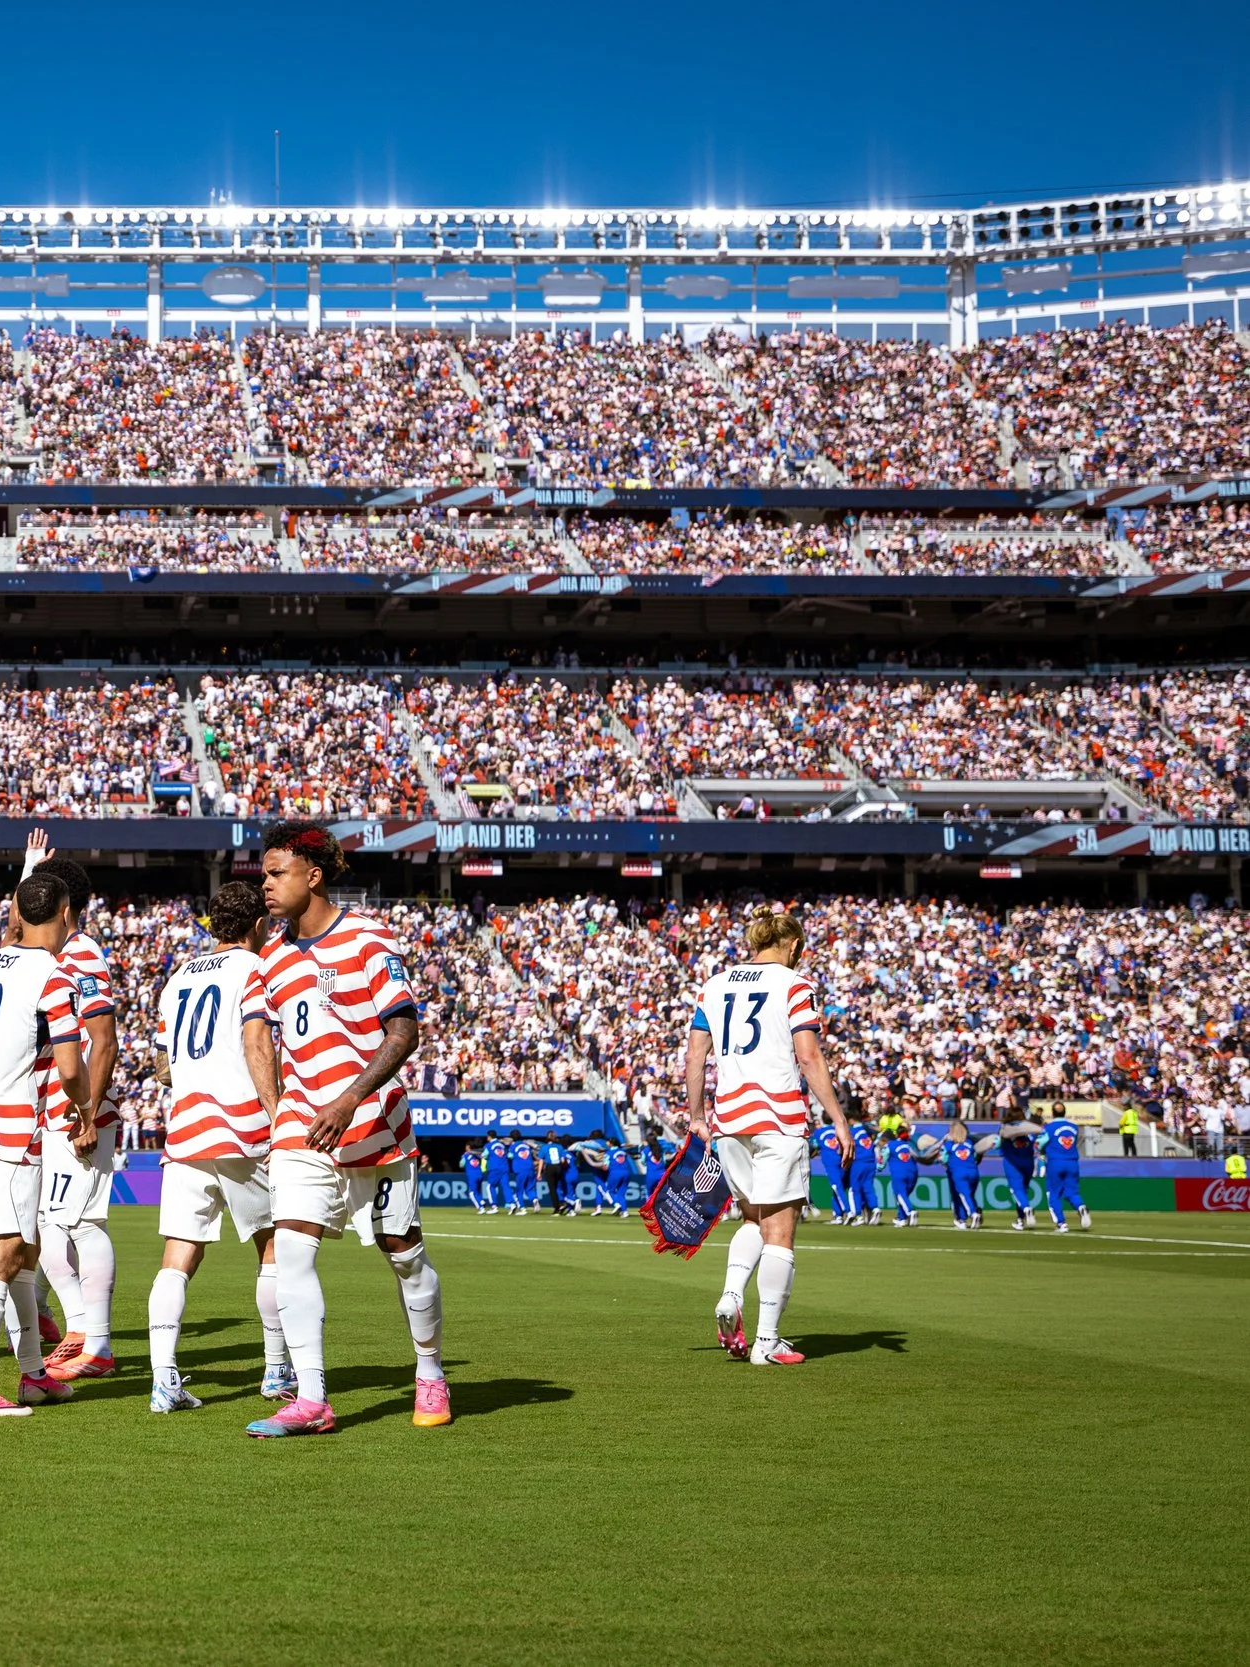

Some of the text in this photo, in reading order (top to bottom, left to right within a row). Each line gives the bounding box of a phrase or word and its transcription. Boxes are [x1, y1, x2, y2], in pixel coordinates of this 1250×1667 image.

[232, 823, 244, 847] U
[363, 824, 384, 847] SA
[436, 824, 535, 848] NIA AND HER
[943, 826, 955, 851] U
[1076, 828, 1098, 851] SA
[1149, 827, 1250, 852] NIA AND HER
[183, 955, 230, 975] PULISIC
[319, 969, 336, 981] USA
[728, 969, 764, 983] REAM
[171, 984, 222, 1064] 10
[296, 1000, 309, 1037] 8
[722, 991, 769, 1057] 13
[411, 1108, 574, 1126] RLD CUP 2026
[703, 1152, 722, 1176] USA
[49, 1172, 73, 1203] 17
[373, 1176, 393, 1211] 8
[680, 1186, 695, 1203] USA
